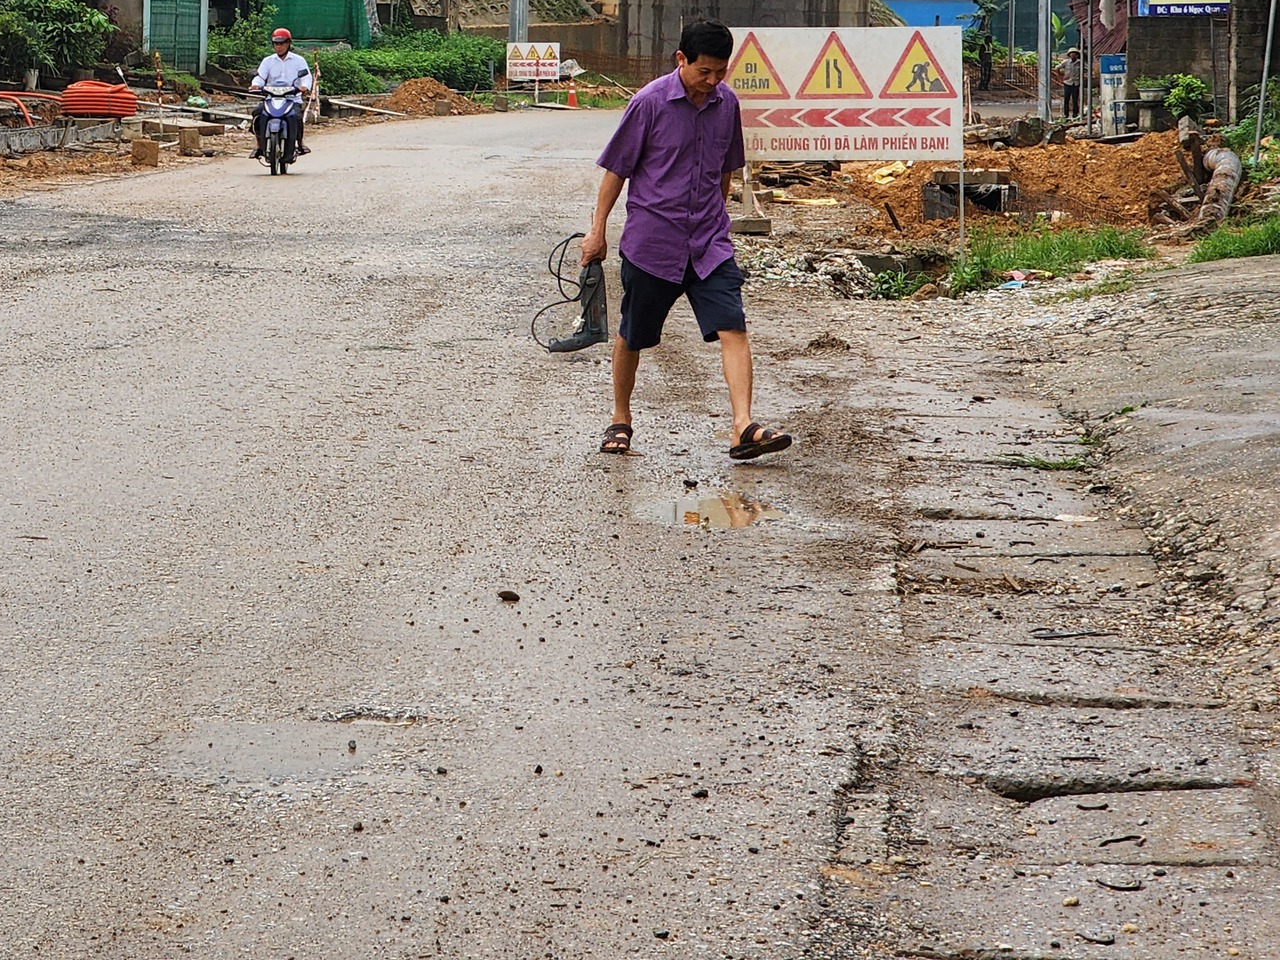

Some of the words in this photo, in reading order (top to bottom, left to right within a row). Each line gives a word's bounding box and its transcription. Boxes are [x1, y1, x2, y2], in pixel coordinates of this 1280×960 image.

[1183, 5, 1188, 13] 6
[745, 63, 757, 74] ĐI
[733, 75, 770, 92] CHẬM
[770, 135, 810, 151] CHÚNG
[813, 135, 831, 151] TÔI
[834, 134, 850, 151] ĐÃ
[854, 134, 878, 150] LÀM
[921, 137, 949, 153] BẠN!
